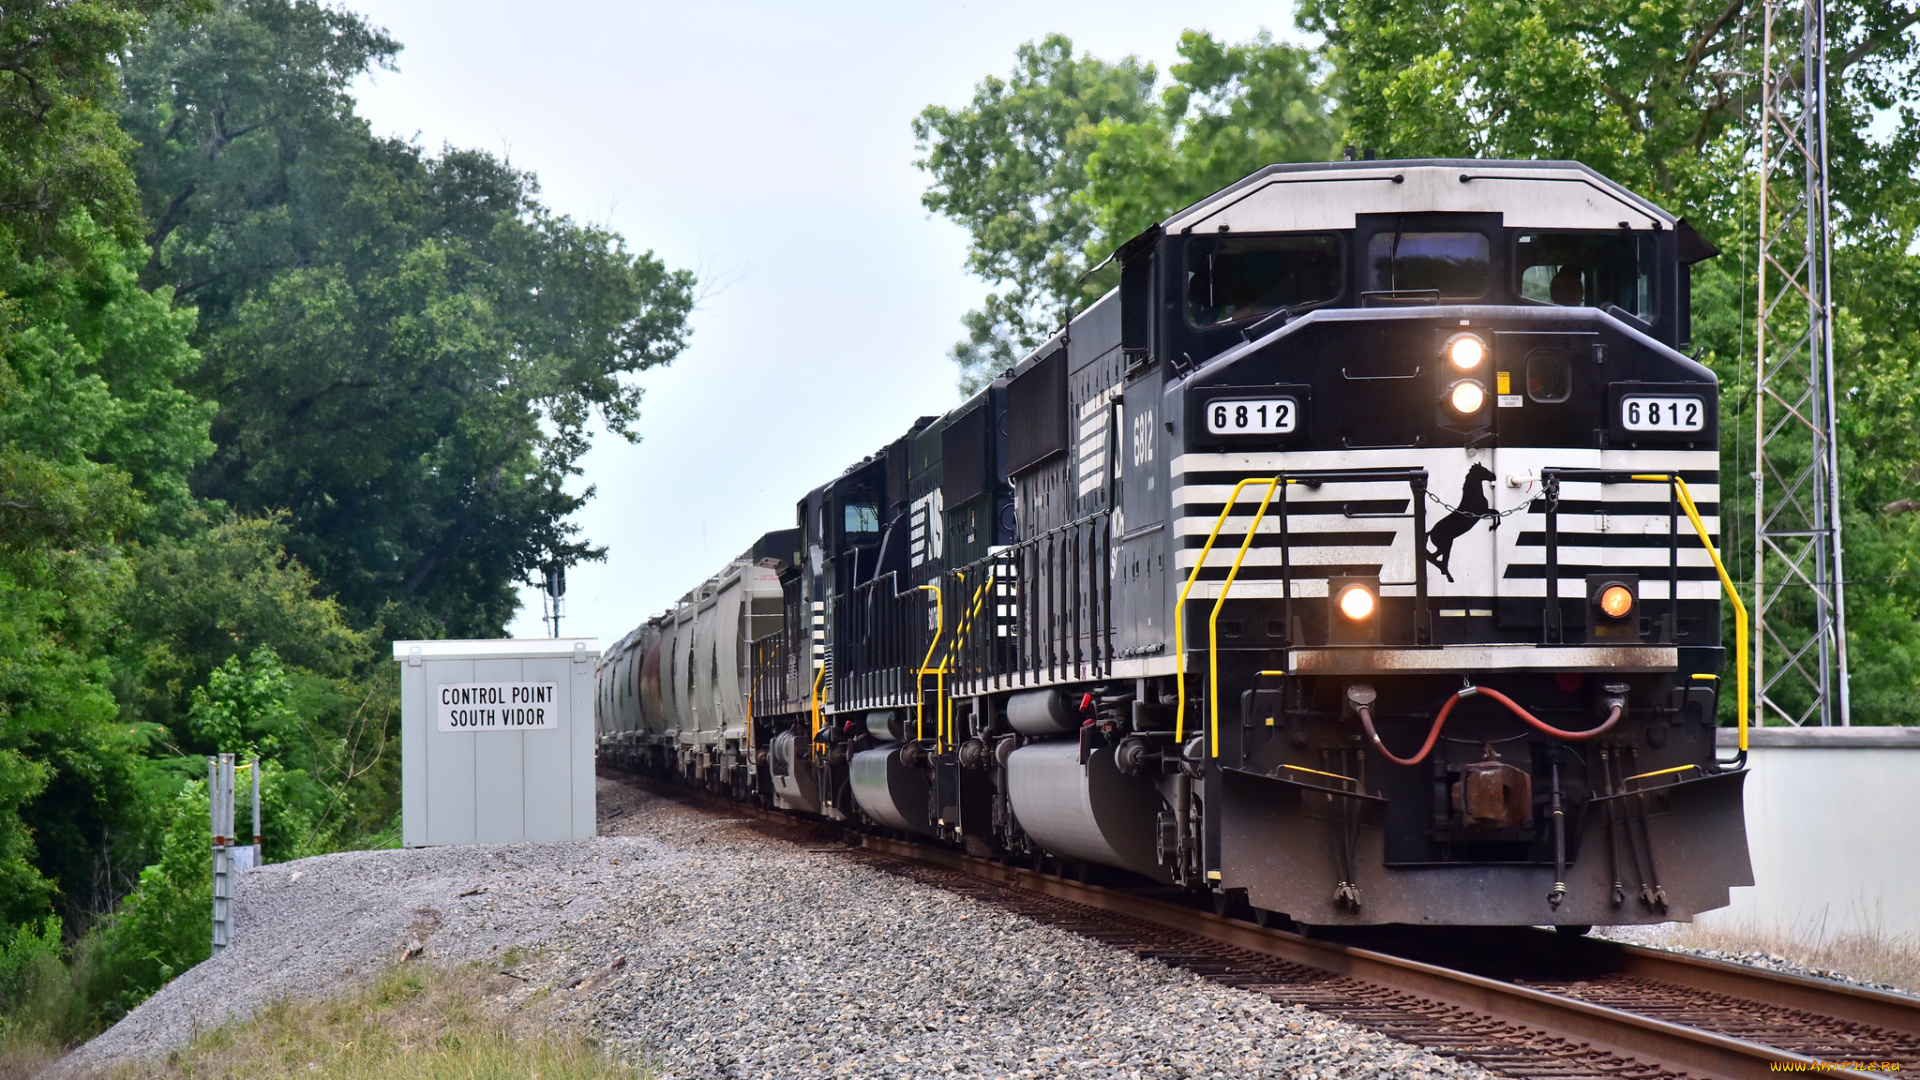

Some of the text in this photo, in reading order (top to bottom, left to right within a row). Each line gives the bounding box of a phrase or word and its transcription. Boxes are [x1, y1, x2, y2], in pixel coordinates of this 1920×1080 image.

[1213, 405, 1289, 429] 6812
[1628, 402, 1697, 426] 6812
[1133, 409, 1153, 467] 6812
[442, 686, 553, 705] CONTROL POINT
[450, 708, 544, 726] SOUTH VIDOR
